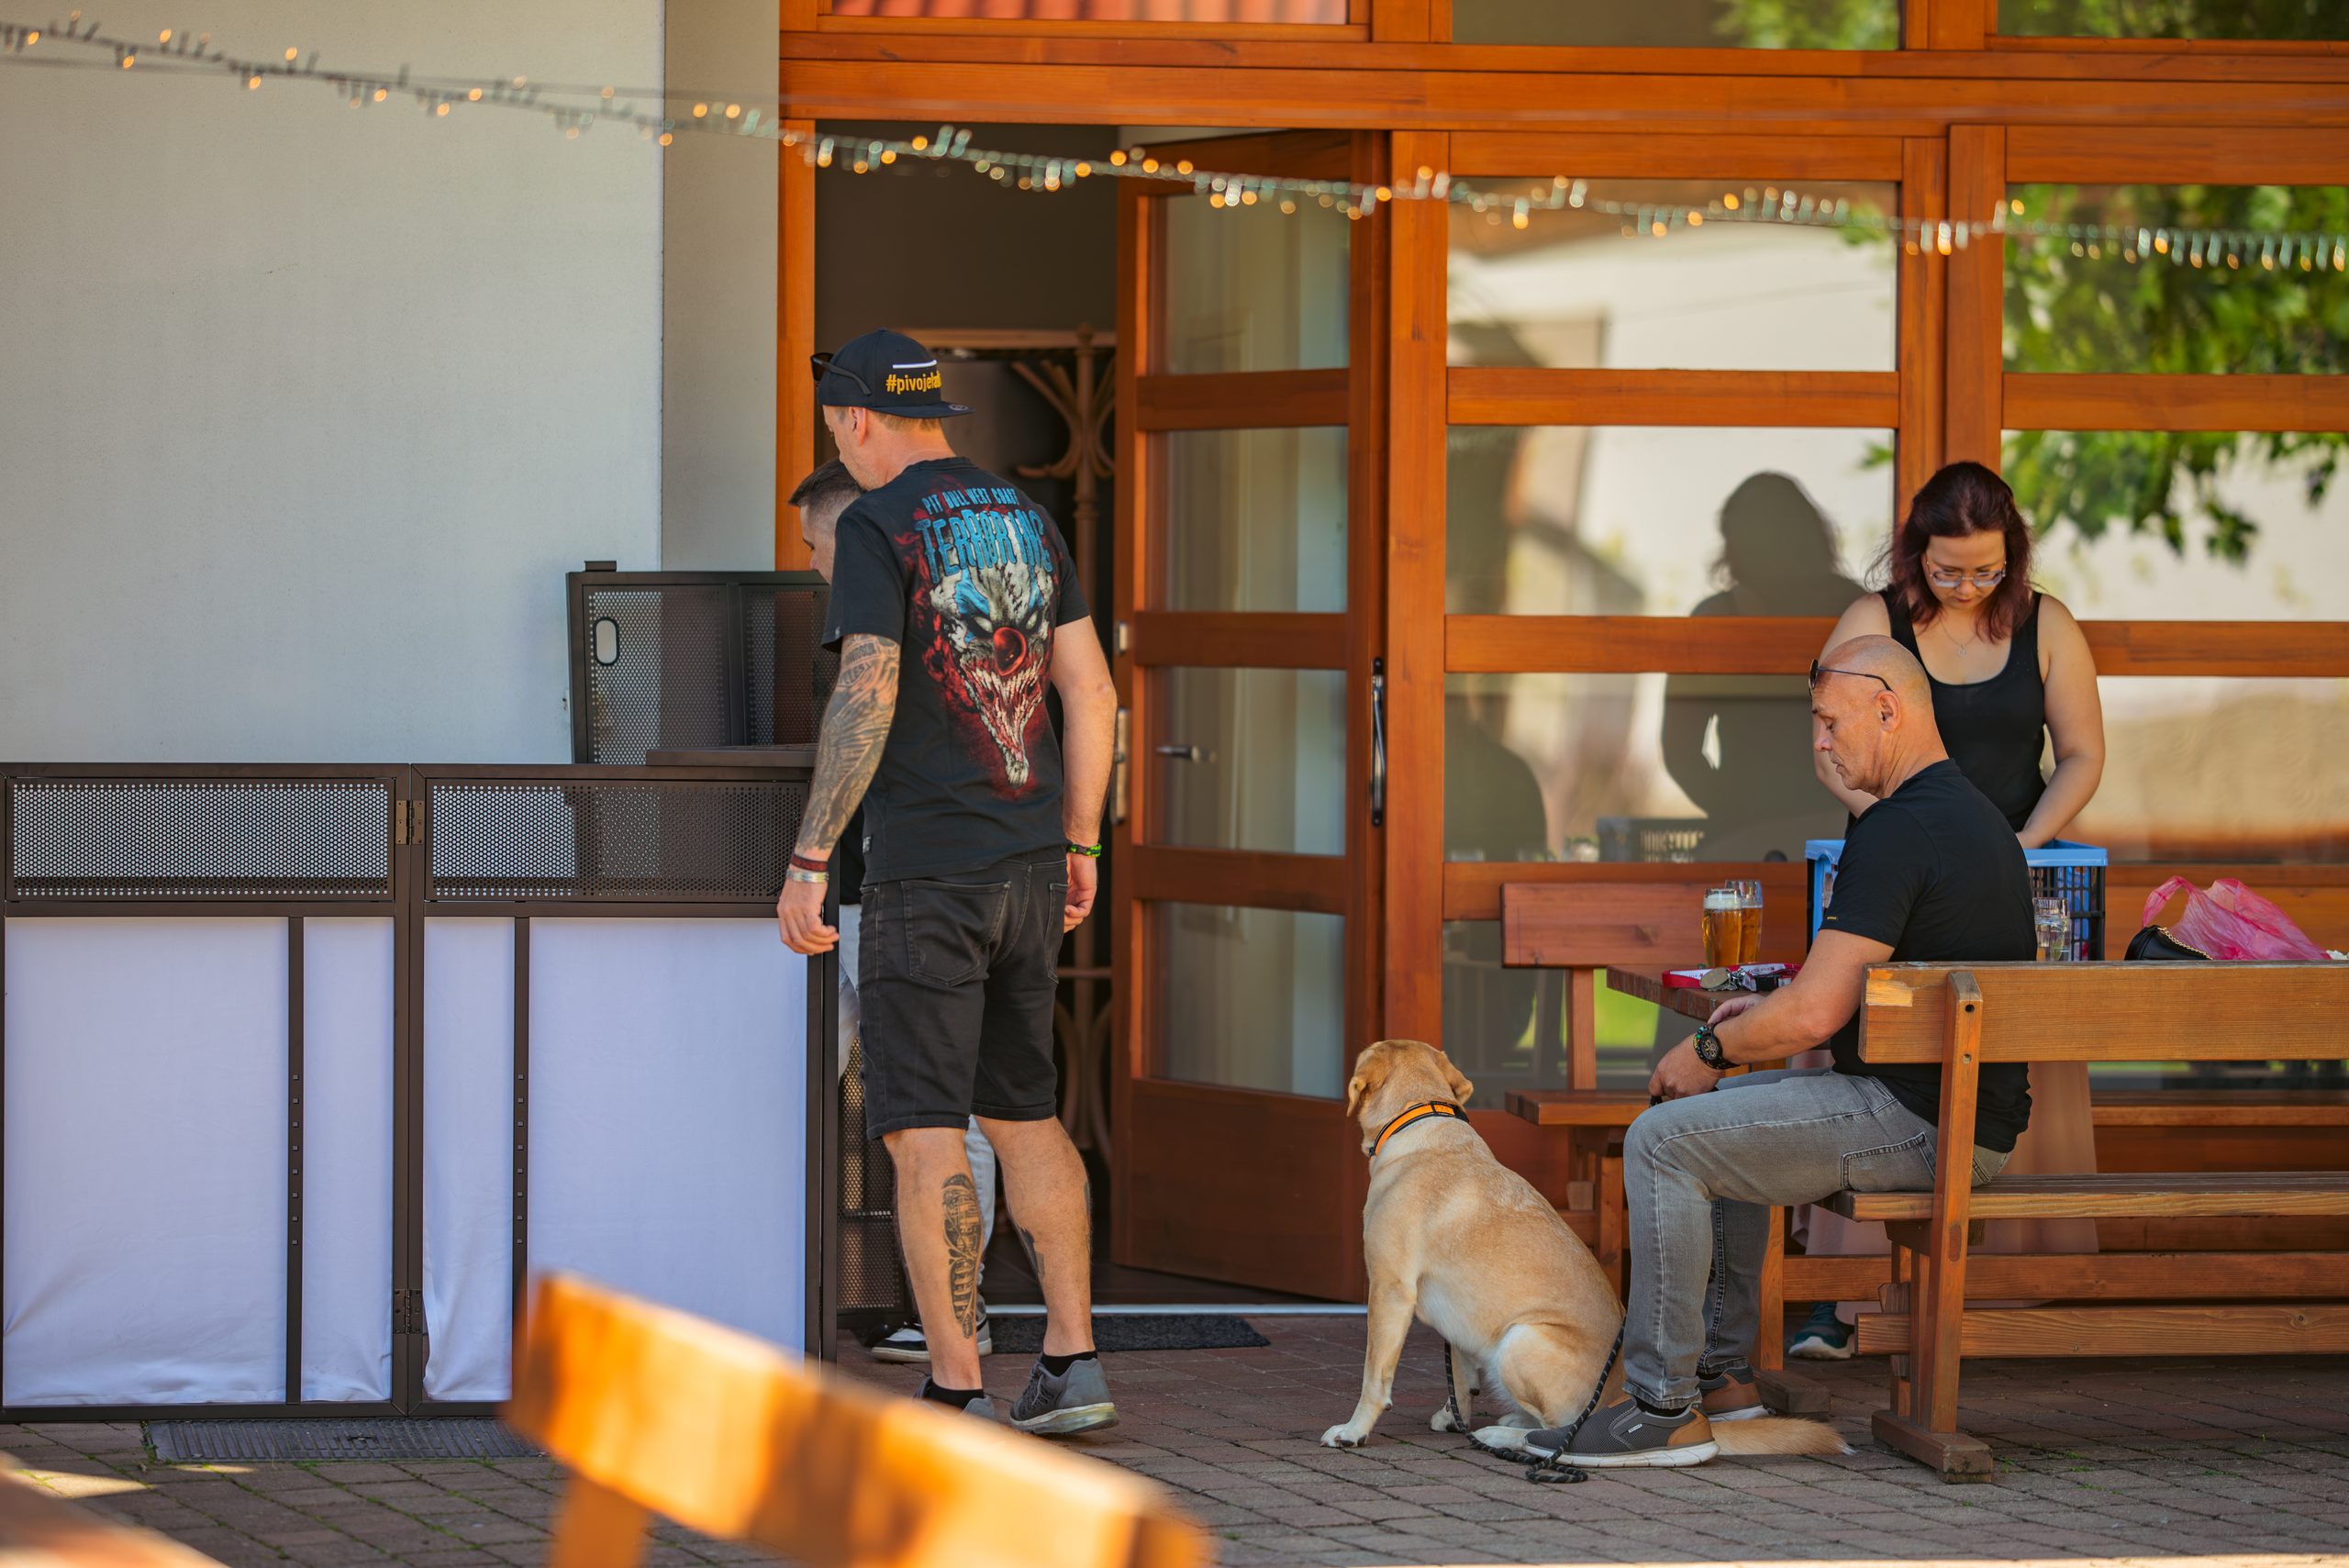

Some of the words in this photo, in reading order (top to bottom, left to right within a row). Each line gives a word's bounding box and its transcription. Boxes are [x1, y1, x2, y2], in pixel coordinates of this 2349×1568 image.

[921, 494, 943, 515] PIT
[941, 489, 970, 509] BULL
[965, 487, 992, 505] WEST
[991, 487, 1019, 506] COAST
[914, 509, 1017, 584] TERROR
